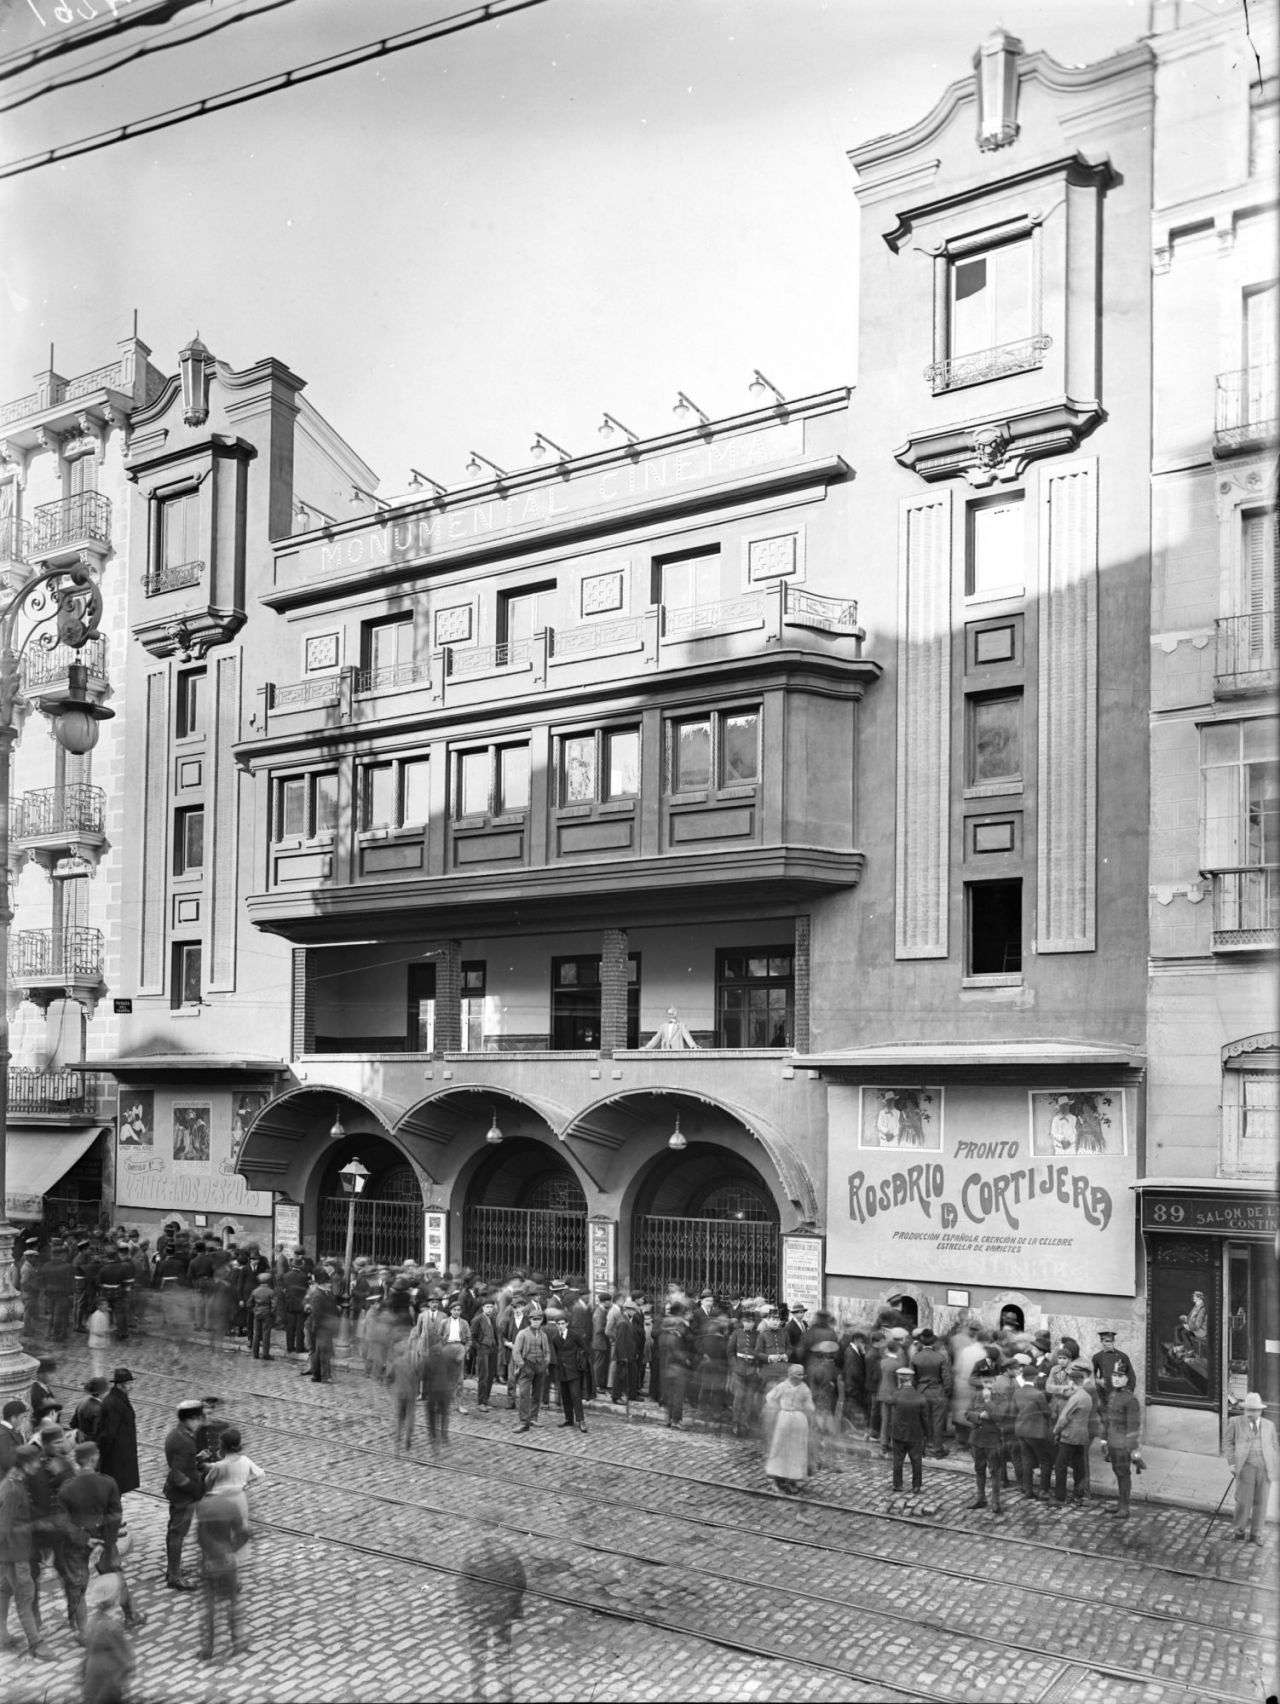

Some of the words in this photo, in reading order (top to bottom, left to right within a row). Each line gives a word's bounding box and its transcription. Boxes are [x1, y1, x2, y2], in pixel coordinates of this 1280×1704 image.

[321, 488, 569, 570] MONUMENTAL
[600, 435, 769, 500] CINEMA
[953, 1140, 1019, 1159] PRONTO
[848, 1163, 944, 1224] ROSARIO
[941, 1202, 958, 1229] LA
[961, 1164, 1112, 1231] CORTIJERA
[1153, 1204, 1185, 1222] 89
[1196, 1207, 1242, 1225] SALON
[1247, 1207, 1263, 1217] DE
[936, 1242, 973, 1250] ESTRELLA
[974, 1244, 983, 1252] DE
[941, 1233, 979, 1242] ESPAÑOLA
[1017, 1237, 1027, 1245] DE
[1028, 1237, 1038, 1246] LA
